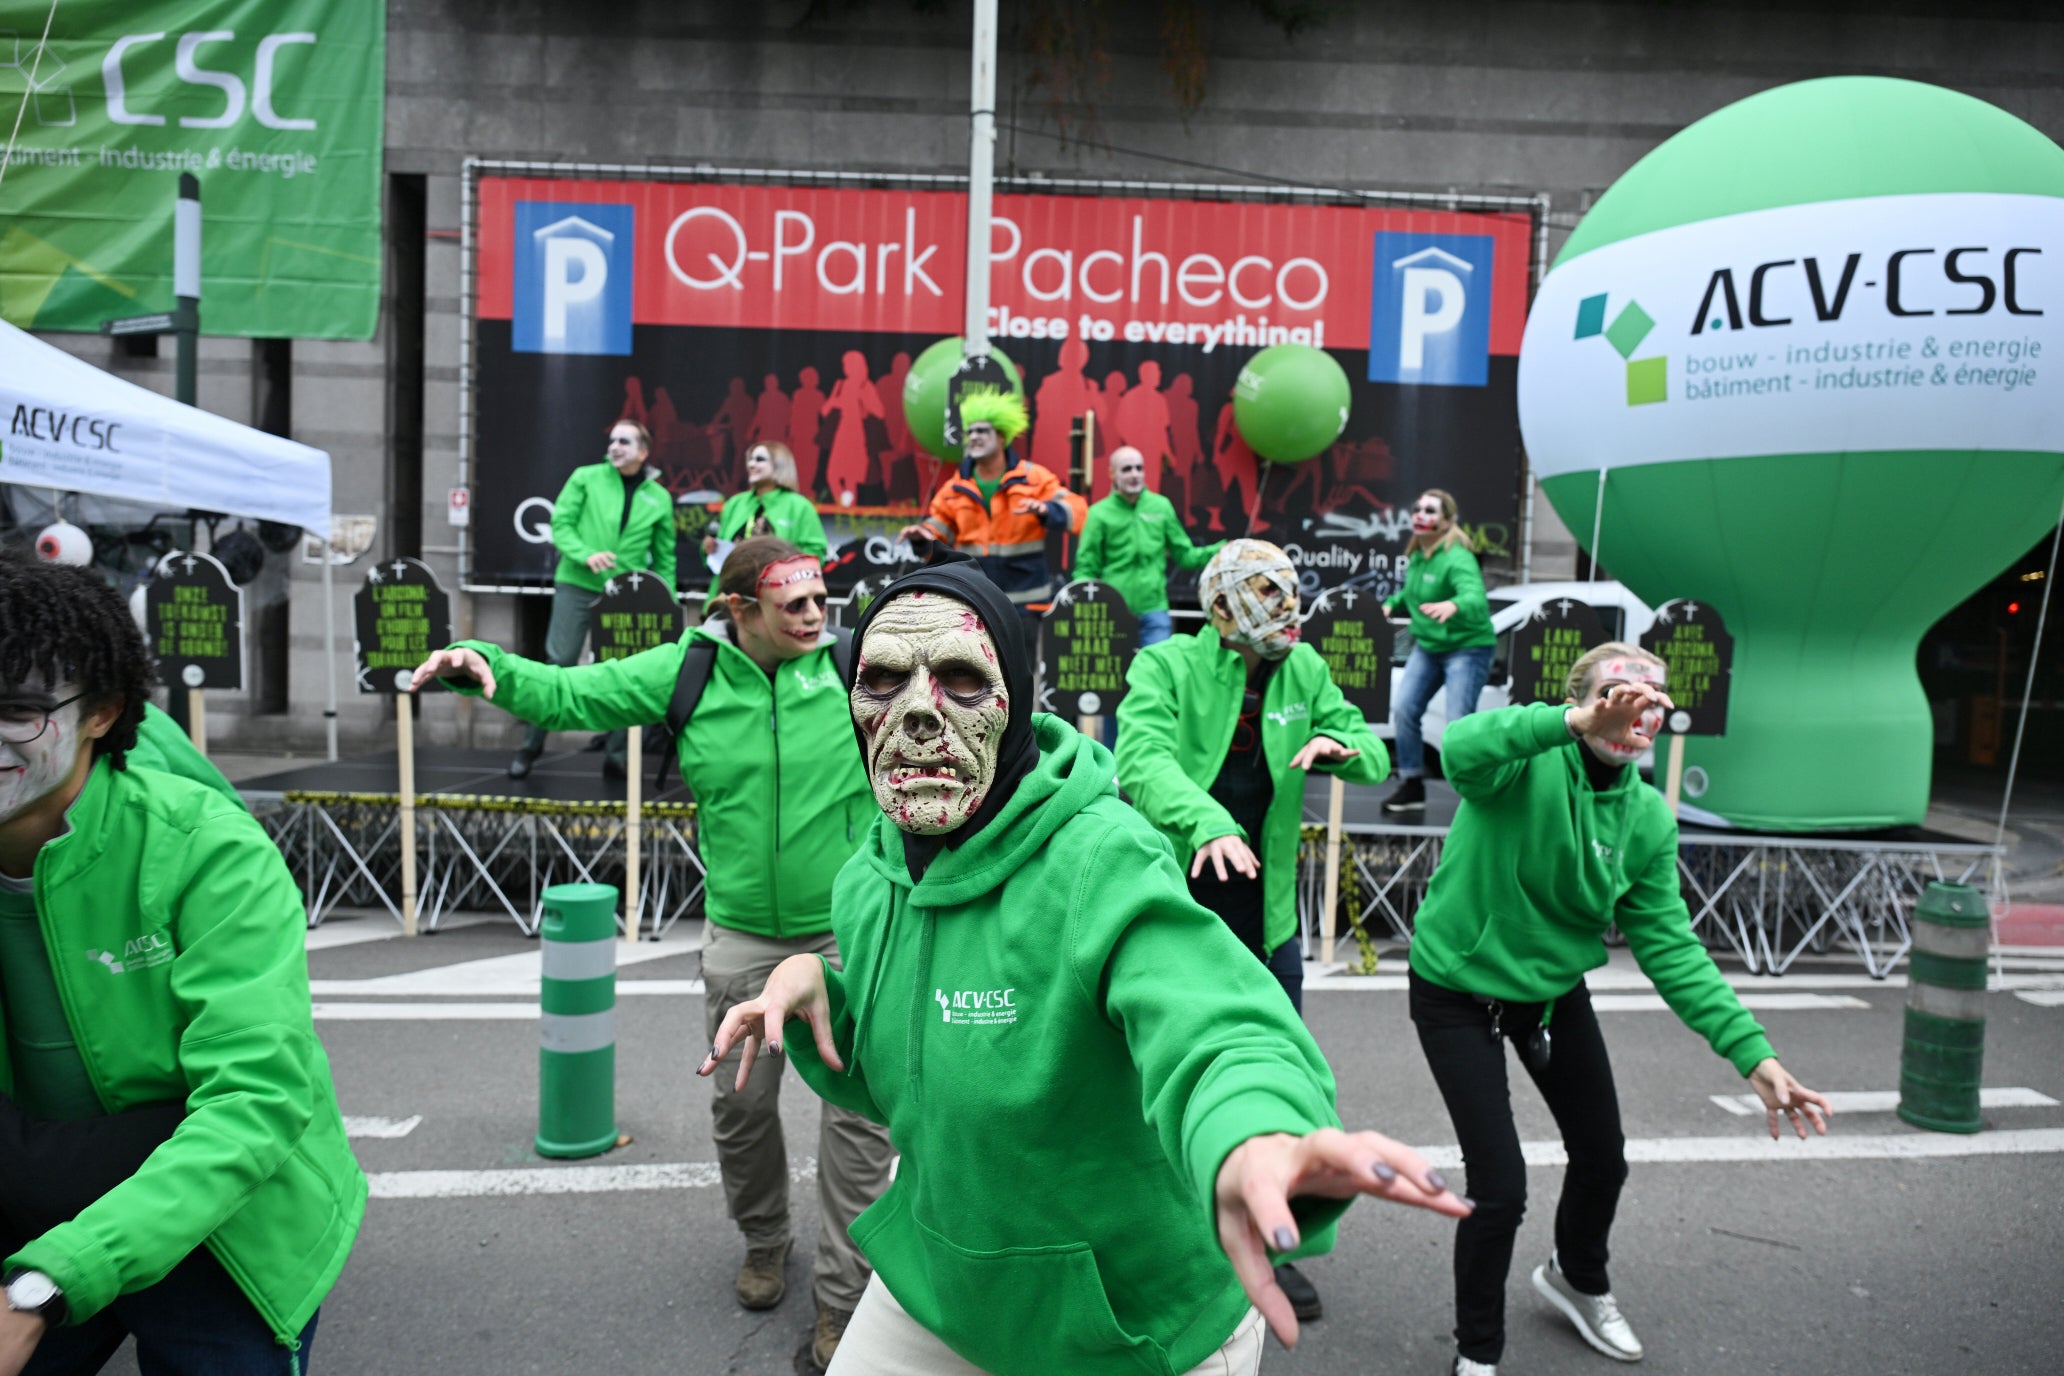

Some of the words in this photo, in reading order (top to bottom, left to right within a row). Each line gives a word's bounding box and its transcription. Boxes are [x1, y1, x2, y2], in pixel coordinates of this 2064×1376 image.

[102, 29, 317, 130] CSC
[0, 143, 80, 167] timent
[100, 143, 201, 171] industrie
[206, 146, 221, 169] &
[227, 146, 318, 178] énergie
[664, 206, 943, 296] Q-Park
[1690, 247, 2044, 336] ACV-CSC
[1079, 314, 1115, 342] to
[1686, 353, 1757, 375] bouw
[1786, 337, 1912, 364] industrie
[1921, 335, 1940, 358] &
[1948, 335, 2042, 364] energie
[1686, 373, 1791, 400] bâtiment
[1815, 364, 1925, 390] industrie
[1930, 362, 1948, 386] &
[1954, 362, 2037, 392] énergie
[1283, 543, 1363, 575] Quality
[1368, 548, 1388, 570] in
[1542, 663, 1570, 682] KOR
[952, 988, 1016, 1009] ACV-CSC
